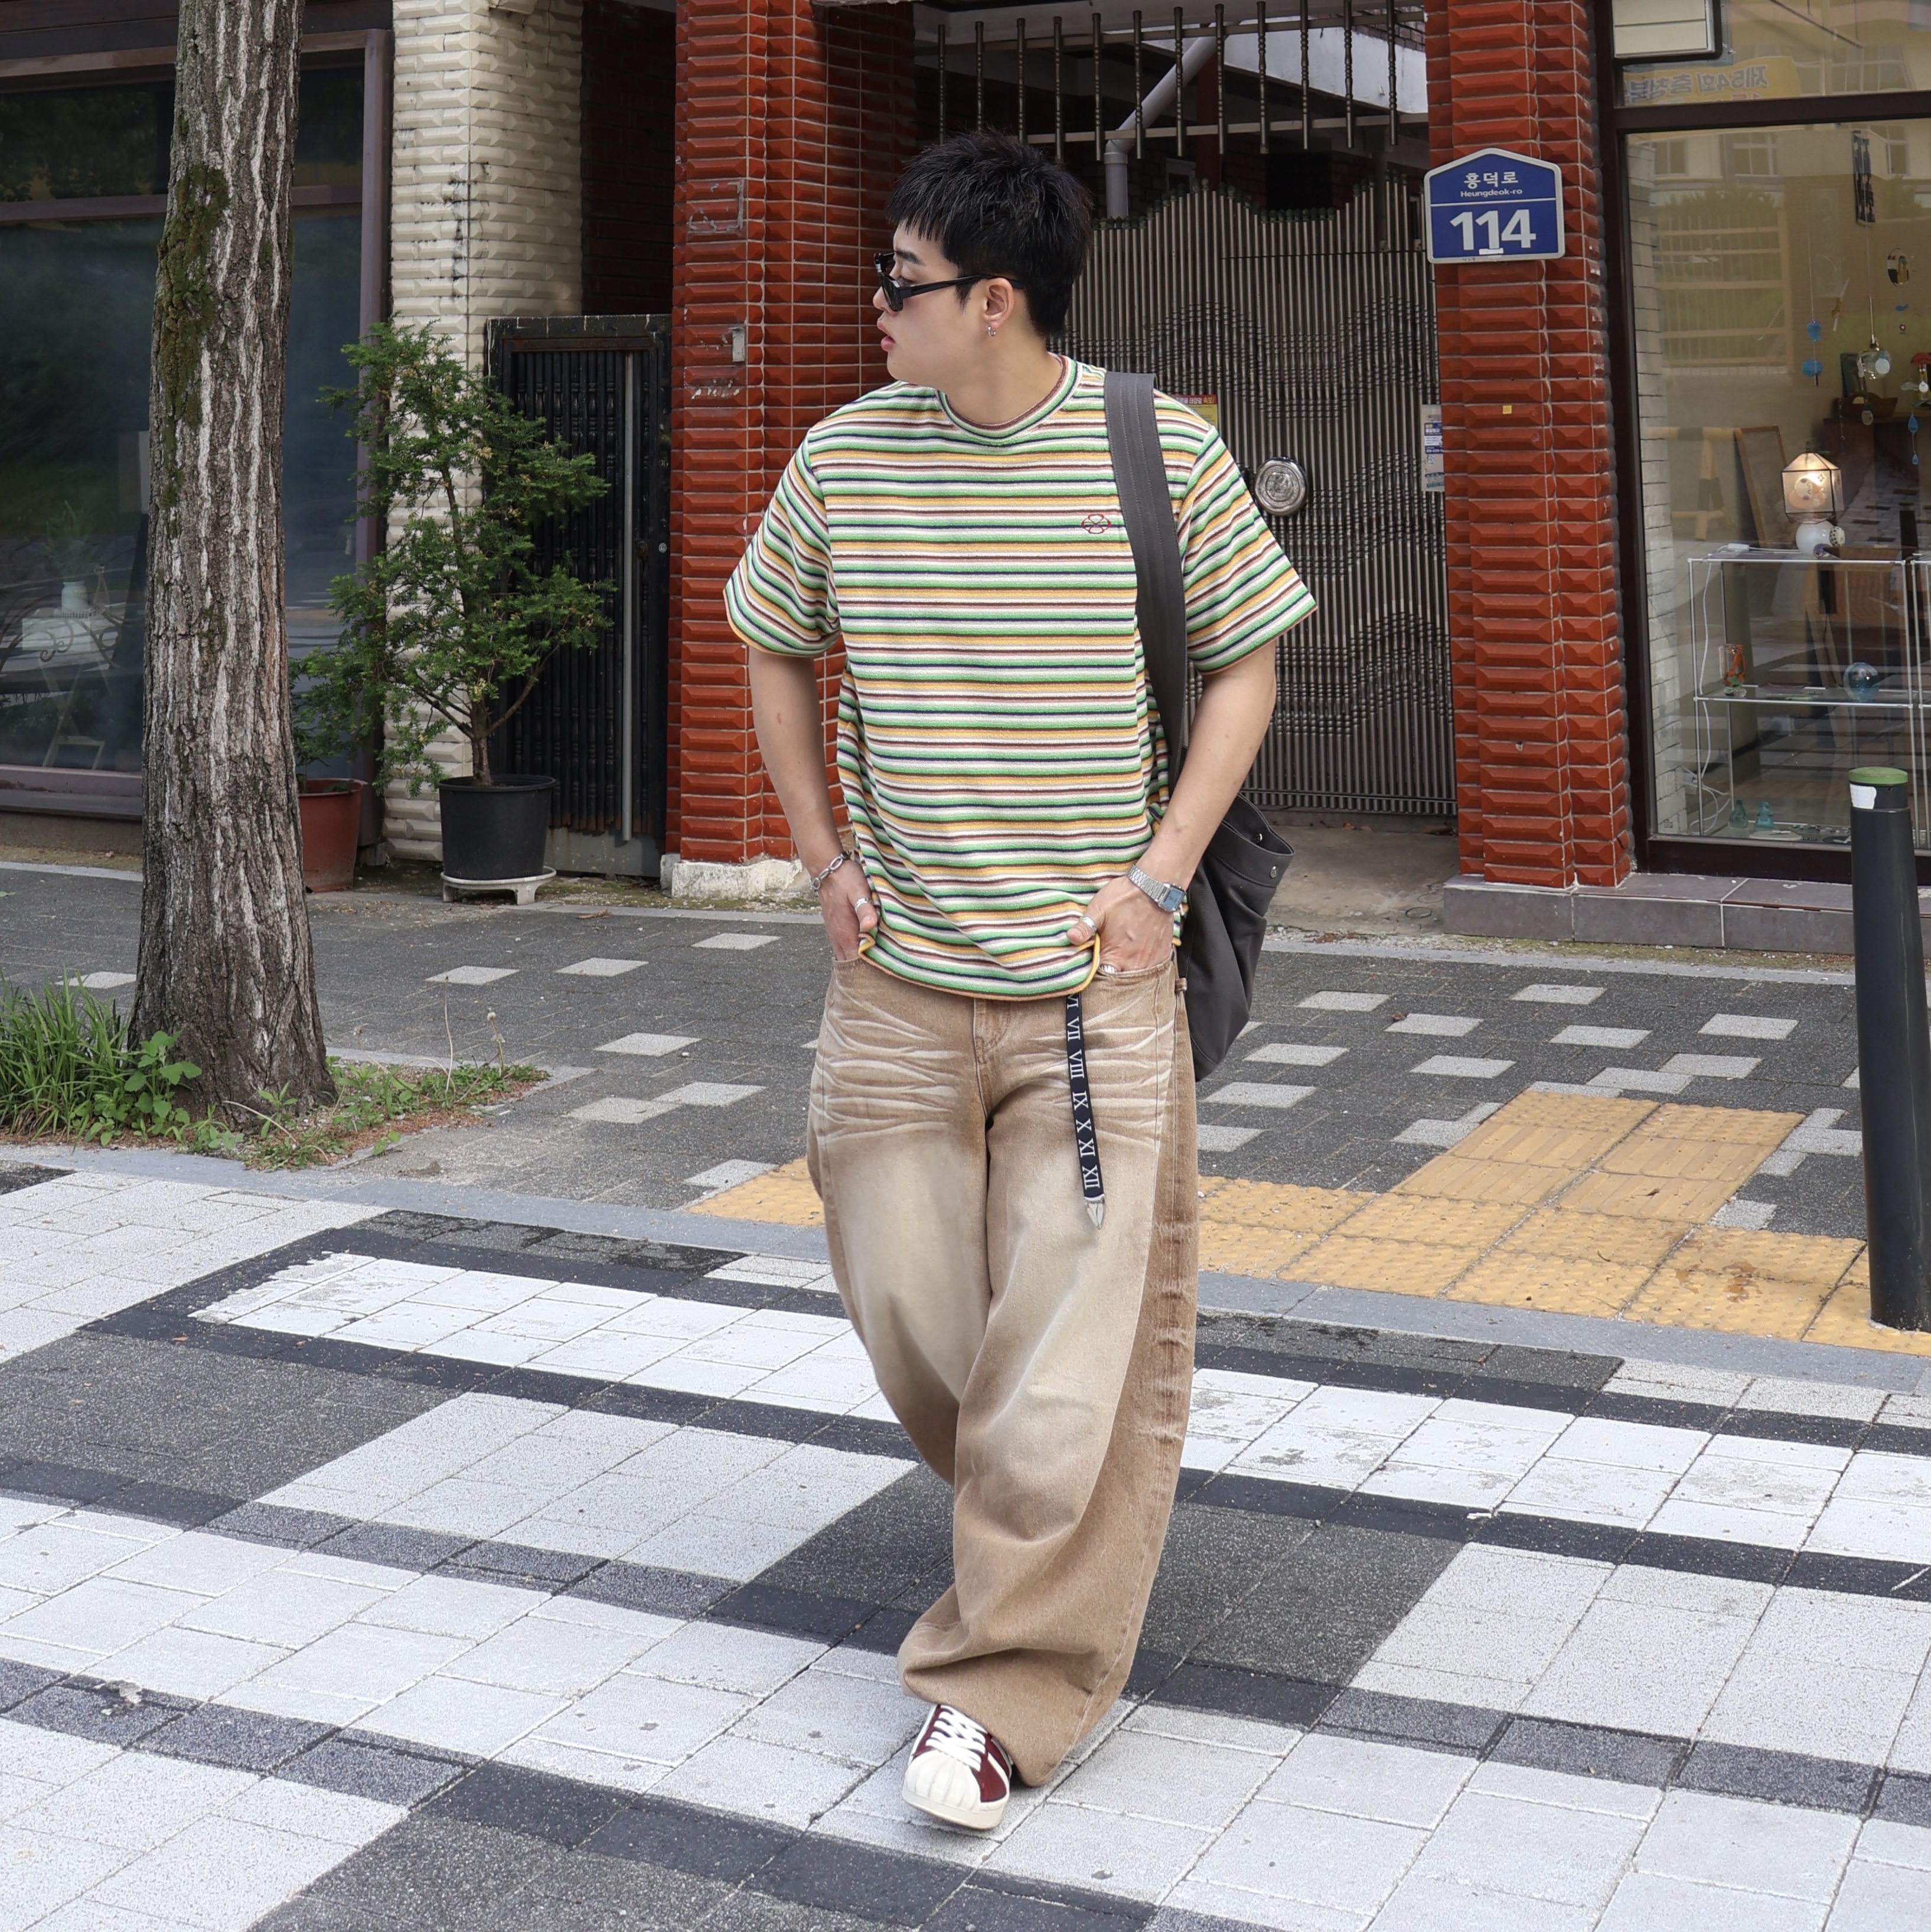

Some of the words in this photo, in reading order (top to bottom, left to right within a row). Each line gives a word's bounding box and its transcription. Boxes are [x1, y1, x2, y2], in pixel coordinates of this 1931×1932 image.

[1464, 171, 1518, 188] 흥덕로
[1460, 188, 1522, 198] Heungdeok-ro
[1450, 209, 1537, 250] 114
[1067, 1016, 1081, 1042] VII
[1069, 1049, 1085, 1079] VIII
[1072, 1091, 1089, 1111] IX
[1076, 1118, 1092, 1133] X
[1078, 1138, 1095, 1158] XI
[1082, 1164, 1100, 1189] XII
